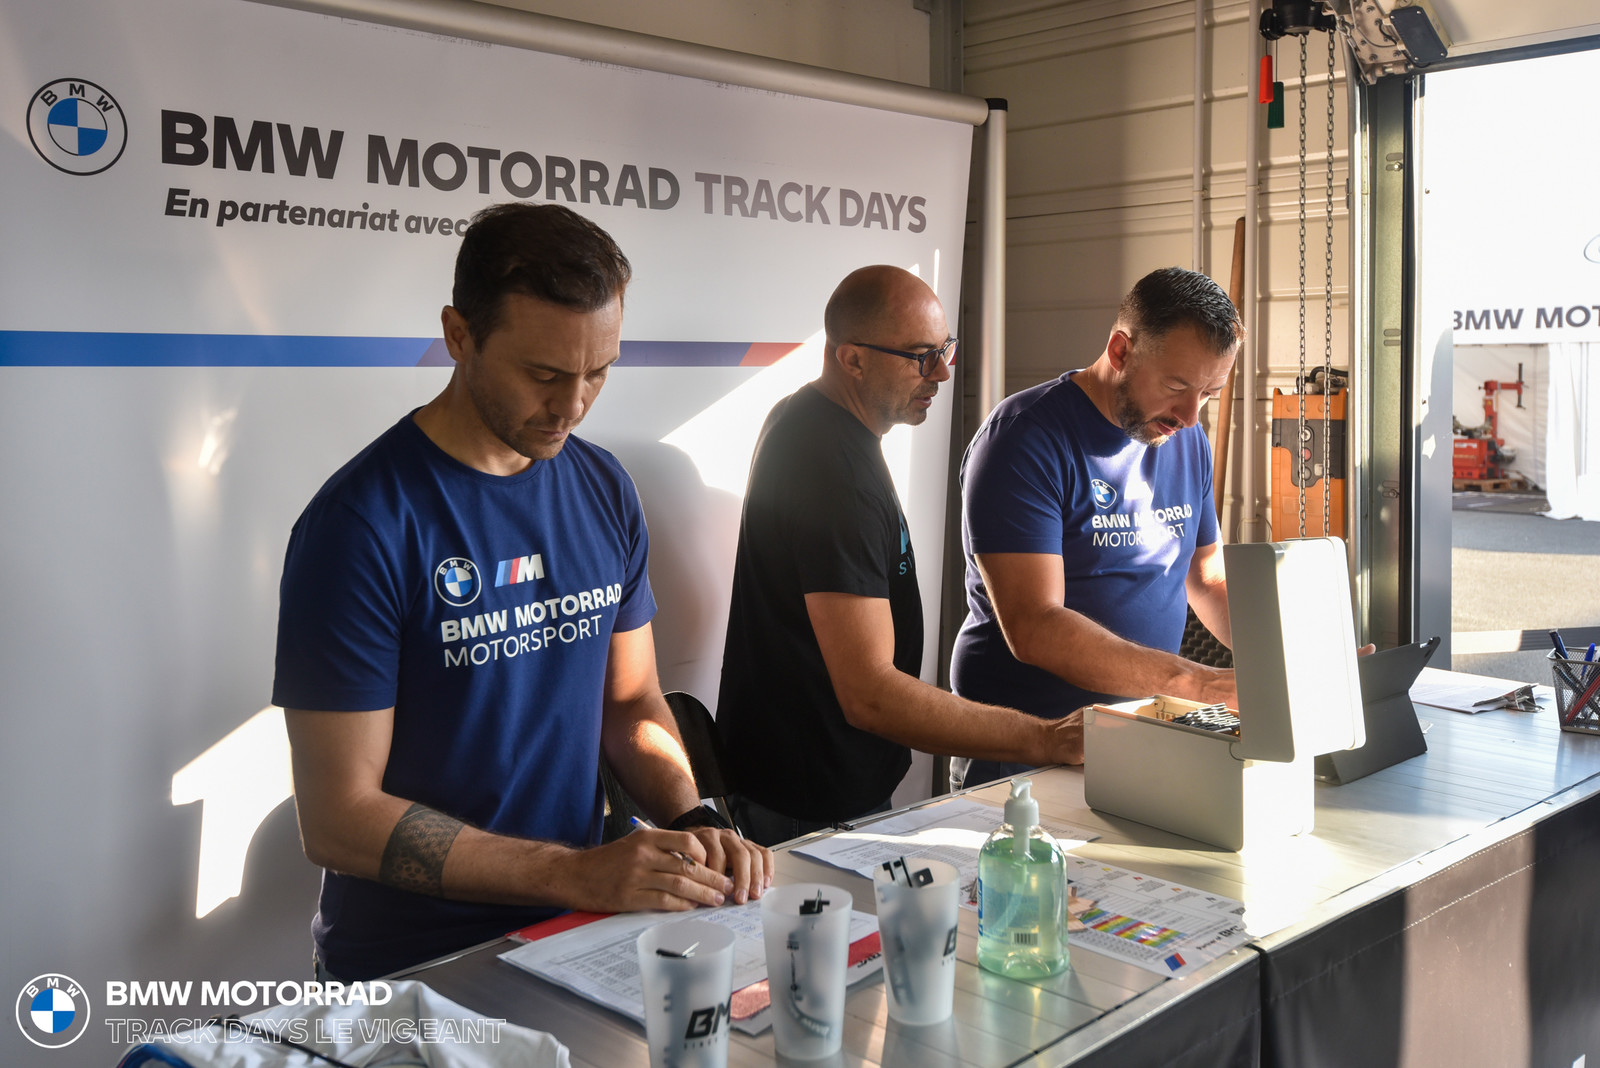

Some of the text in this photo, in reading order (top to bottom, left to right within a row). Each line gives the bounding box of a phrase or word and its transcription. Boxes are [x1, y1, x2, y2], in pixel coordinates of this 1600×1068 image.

[40, 83, 114, 112] BMW
[161, 109, 927, 233] BMW MOTORRAD TRACK DAYS
[164, 187, 469, 237] En partenariat avec
[1092, 514, 1131, 529] BMW
[1093, 523, 1184, 547] MOTORRT
[439, 560, 473, 576] BMW
[441, 583, 622, 643] BMW MOTORRAD
[444, 615, 602, 668] MOTORSPORT
